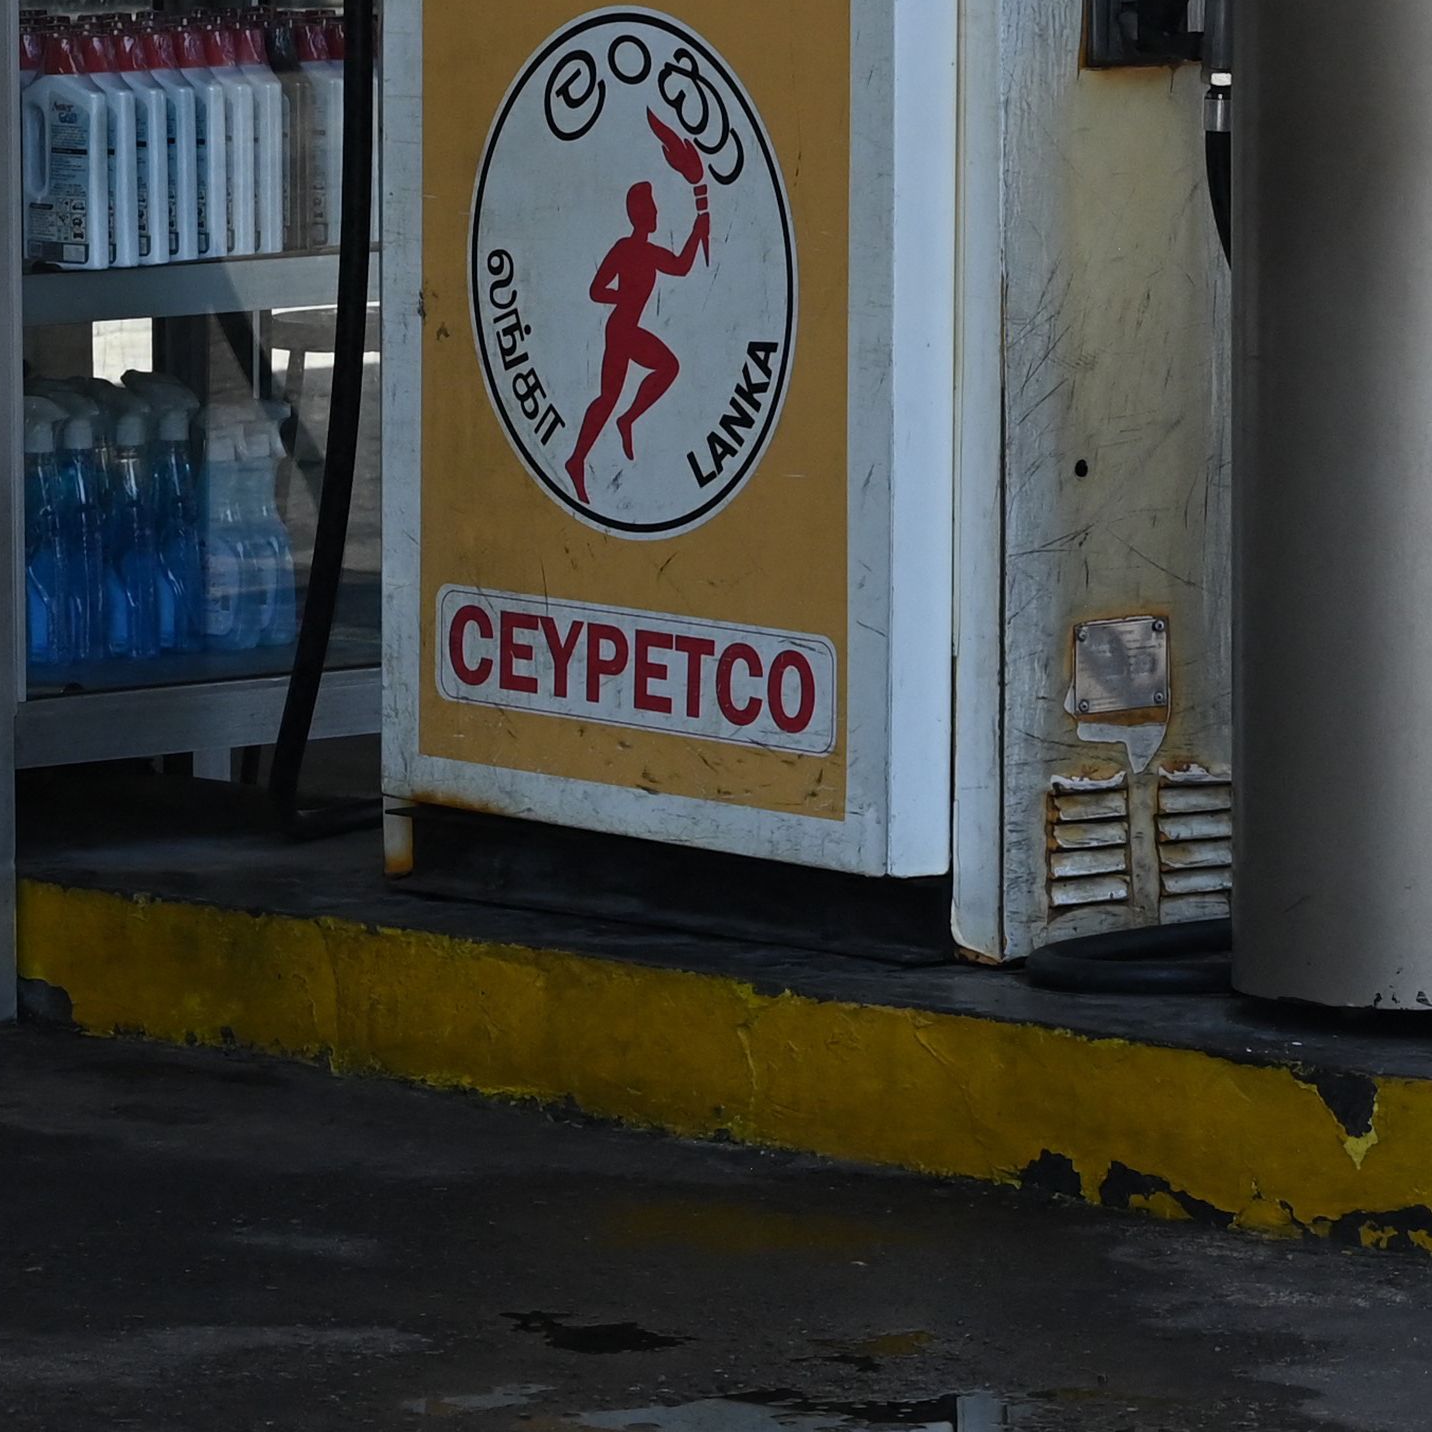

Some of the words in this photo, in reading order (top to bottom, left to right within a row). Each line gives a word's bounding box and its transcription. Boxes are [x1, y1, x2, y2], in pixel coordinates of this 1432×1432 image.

[542, 32, 746, 188] ලංකා
[486, 247, 567, 449] லங்கா
[685, 338, 780, 491] LANKA
[447, 603, 817, 736] CEYPETCO
